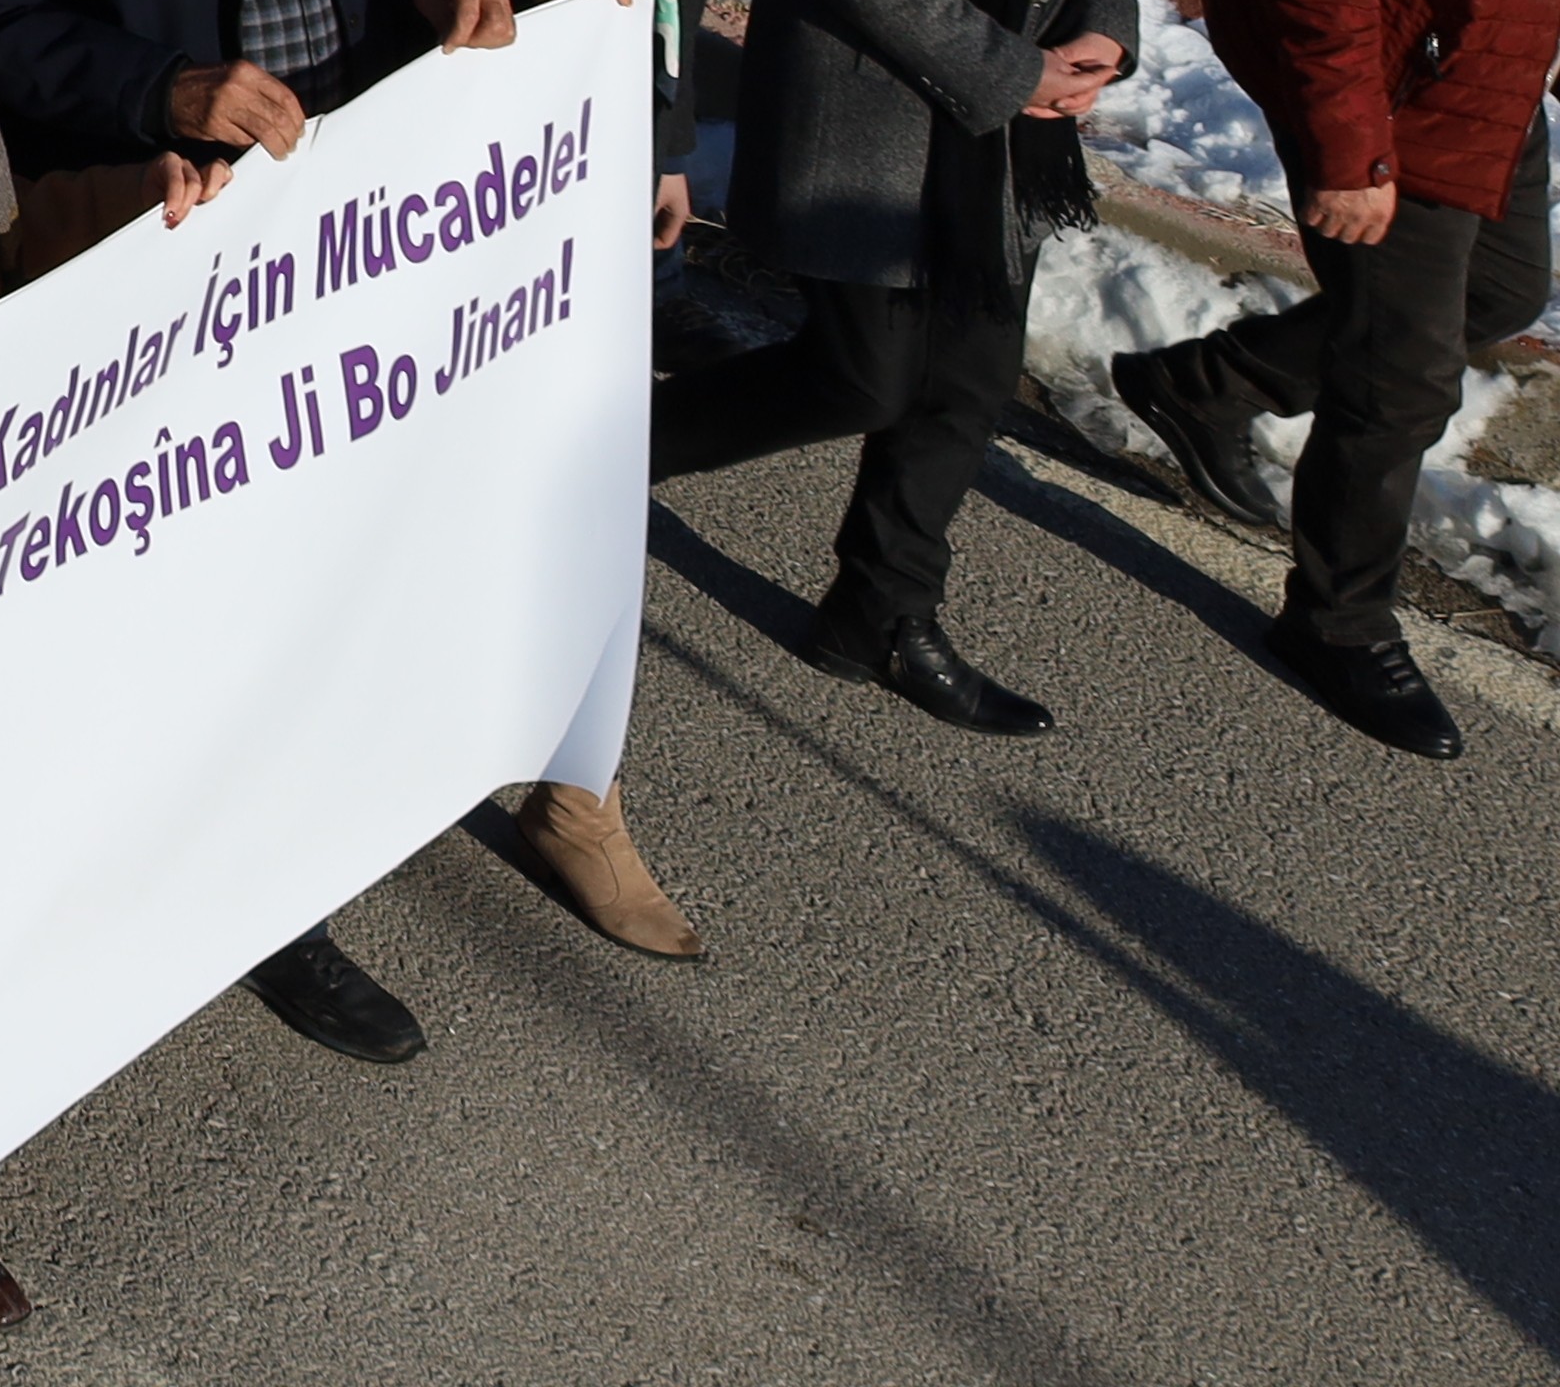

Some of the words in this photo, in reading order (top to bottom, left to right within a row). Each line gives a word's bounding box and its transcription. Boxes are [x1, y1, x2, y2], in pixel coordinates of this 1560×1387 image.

[193, 244, 295, 368] İçin
[315, 97, 592, 299] Mücadele!
[268, 364, 325, 470] Ji
[340, 342, 417, 442] Bo
[434, 237, 574, 396] Jinan!
